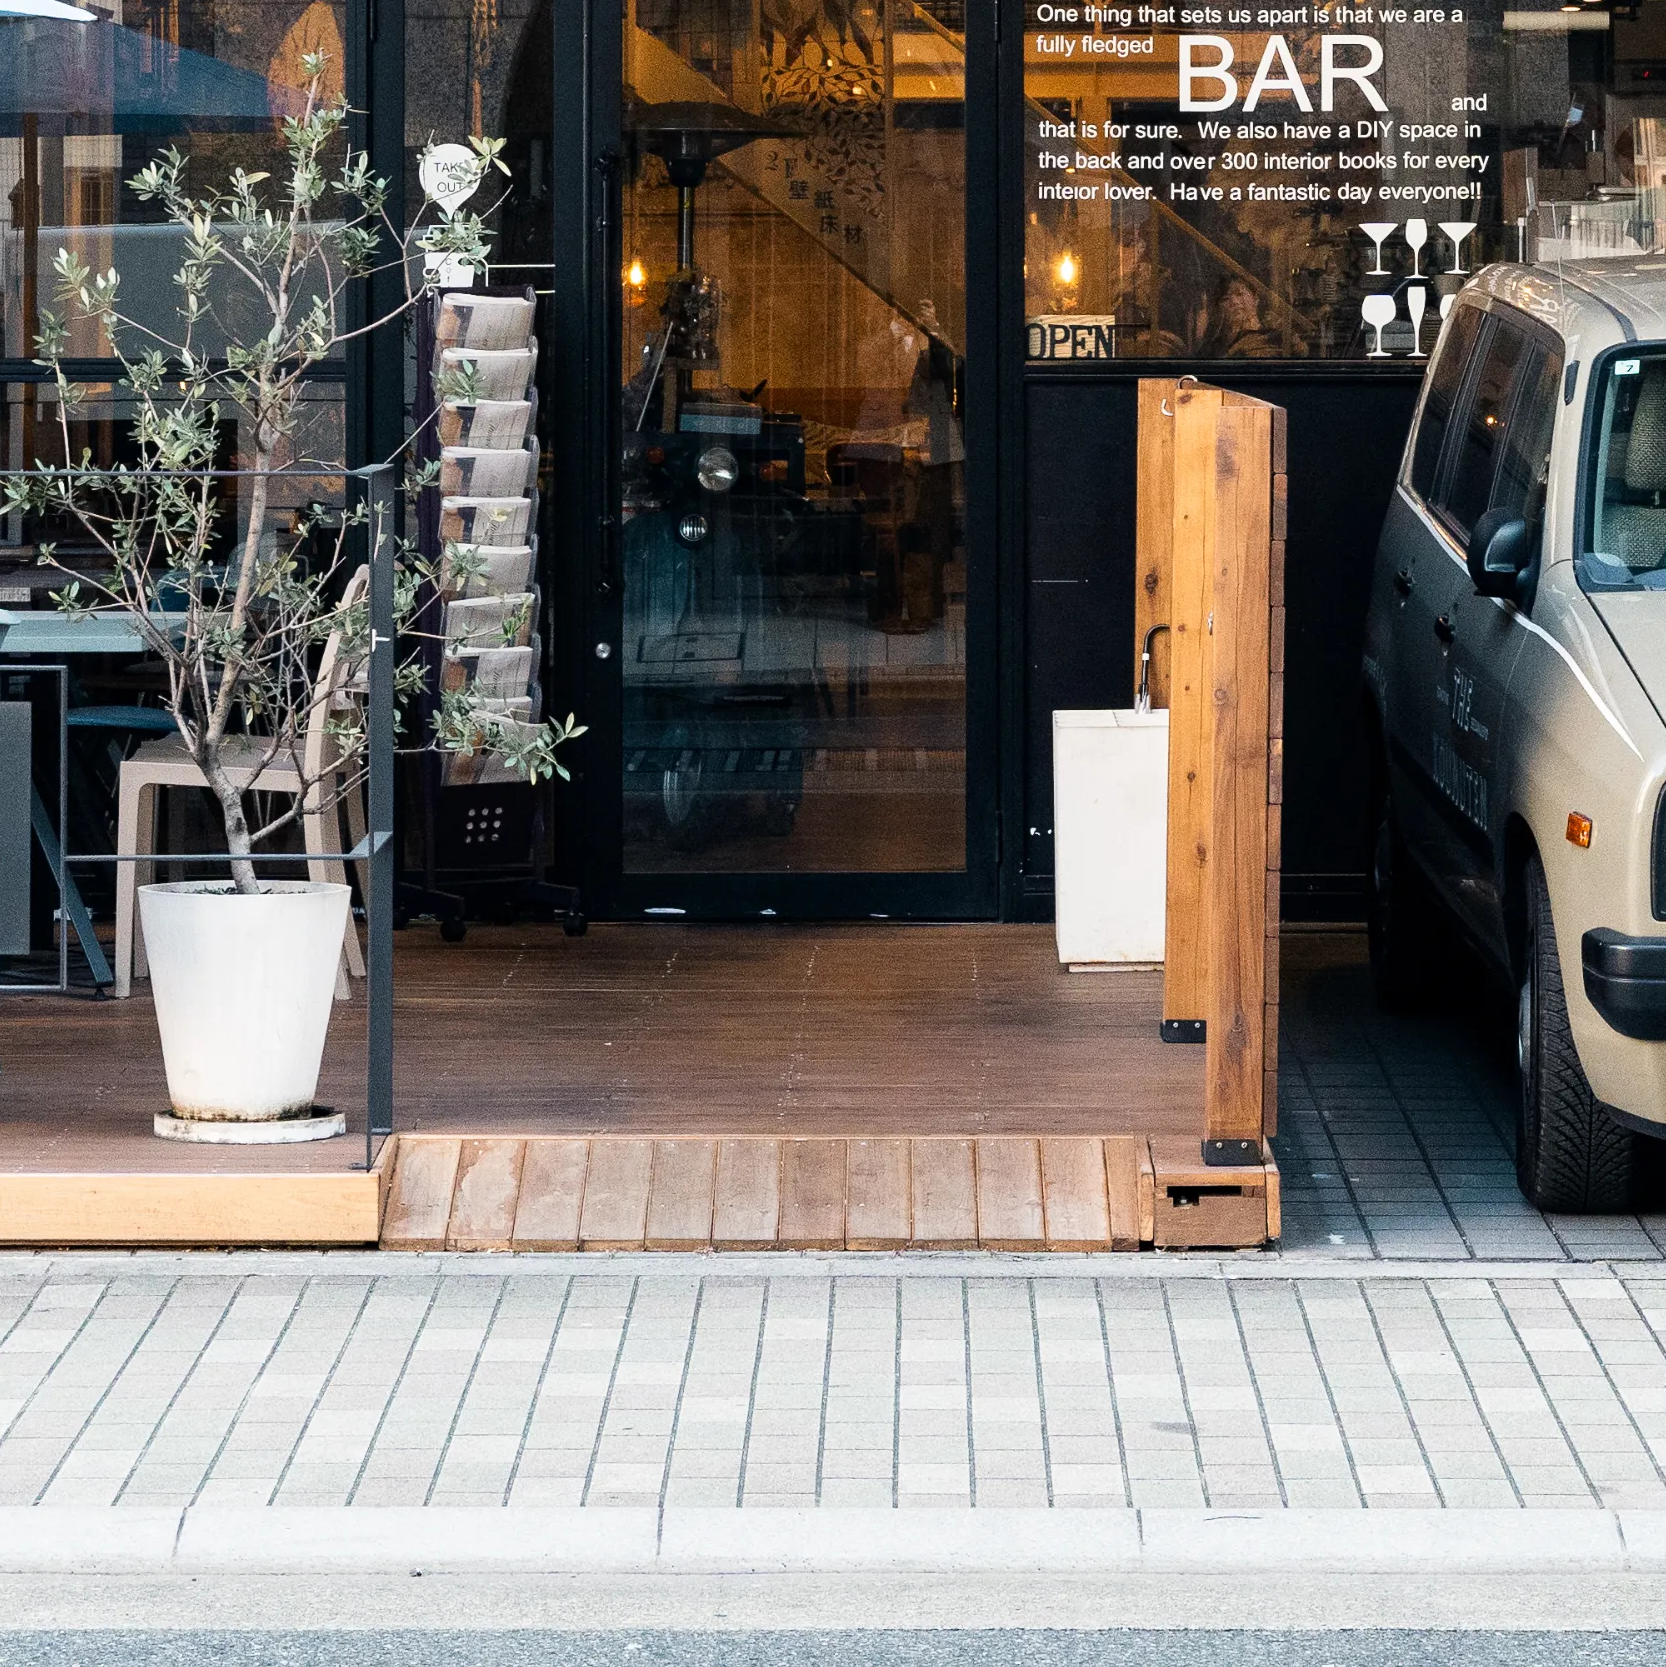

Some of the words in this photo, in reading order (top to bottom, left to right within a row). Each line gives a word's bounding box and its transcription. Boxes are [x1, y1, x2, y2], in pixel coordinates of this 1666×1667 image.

[1037, 4, 1078, 21] One
[1085, 5, 1131, 26] thing
[1138, 5, 1175, 22] that
[1181, 7, 1221, 23] sets
[1229, 10, 1251, 23] us
[1258, 7, 1307, 26] apart
[1314, 10, 1329, 22] is
[1336, 6, 1373, 23] that
[1379, 10, 1407, 22] we
[1414, 10, 1444, 22] are
[1452, 10, 1462, 22] a
[1037, 35, 1075, 56] fully
[1082, 36, 1153, 57] fledged
[1179, 35, 1389, 111] BAR
[1452, 94, 1486, 111] and
[1039, 121, 1075, 137] that
[1082, 125, 1097, 137] is
[1103, 121, 1130, 137] for
[1136, 125, 1182, 138] sure.
[1198, 122, 1230, 138] We
[1237, 122, 1277, 138] also
[1284, 122, 1331, 138] have
[1339, 126, 1350, 138] a
[1358, 121, 1393, 137] DIY
[1400, 125, 1457, 141] space
[1465, 125, 1480, 137] in
[1039, 152, 1069, 168] the
[1076, 152, 1121, 168] back
[1128, 153, 1163, 169] and
[1171, 157, 1215, 169] over
[1222, 153, 1257, 169] 300
[1265, 153, 1331, 169] interior
[1340, 152, 1397, 168] books
[1403, 152, 1429, 168] for
[1436, 156, 1489, 172] every
[1105, 183, 1157, 200] lover.
[1171, 183, 1223, 200] Have
[1230, 188, 1241, 200] a
[1248, 183, 1330, 200] fantastic
[1338, 183, 1372, 204] day
[1379, 182, 1480, 203] everyone!!
[1025, 323, 1116, 358] OPEN
